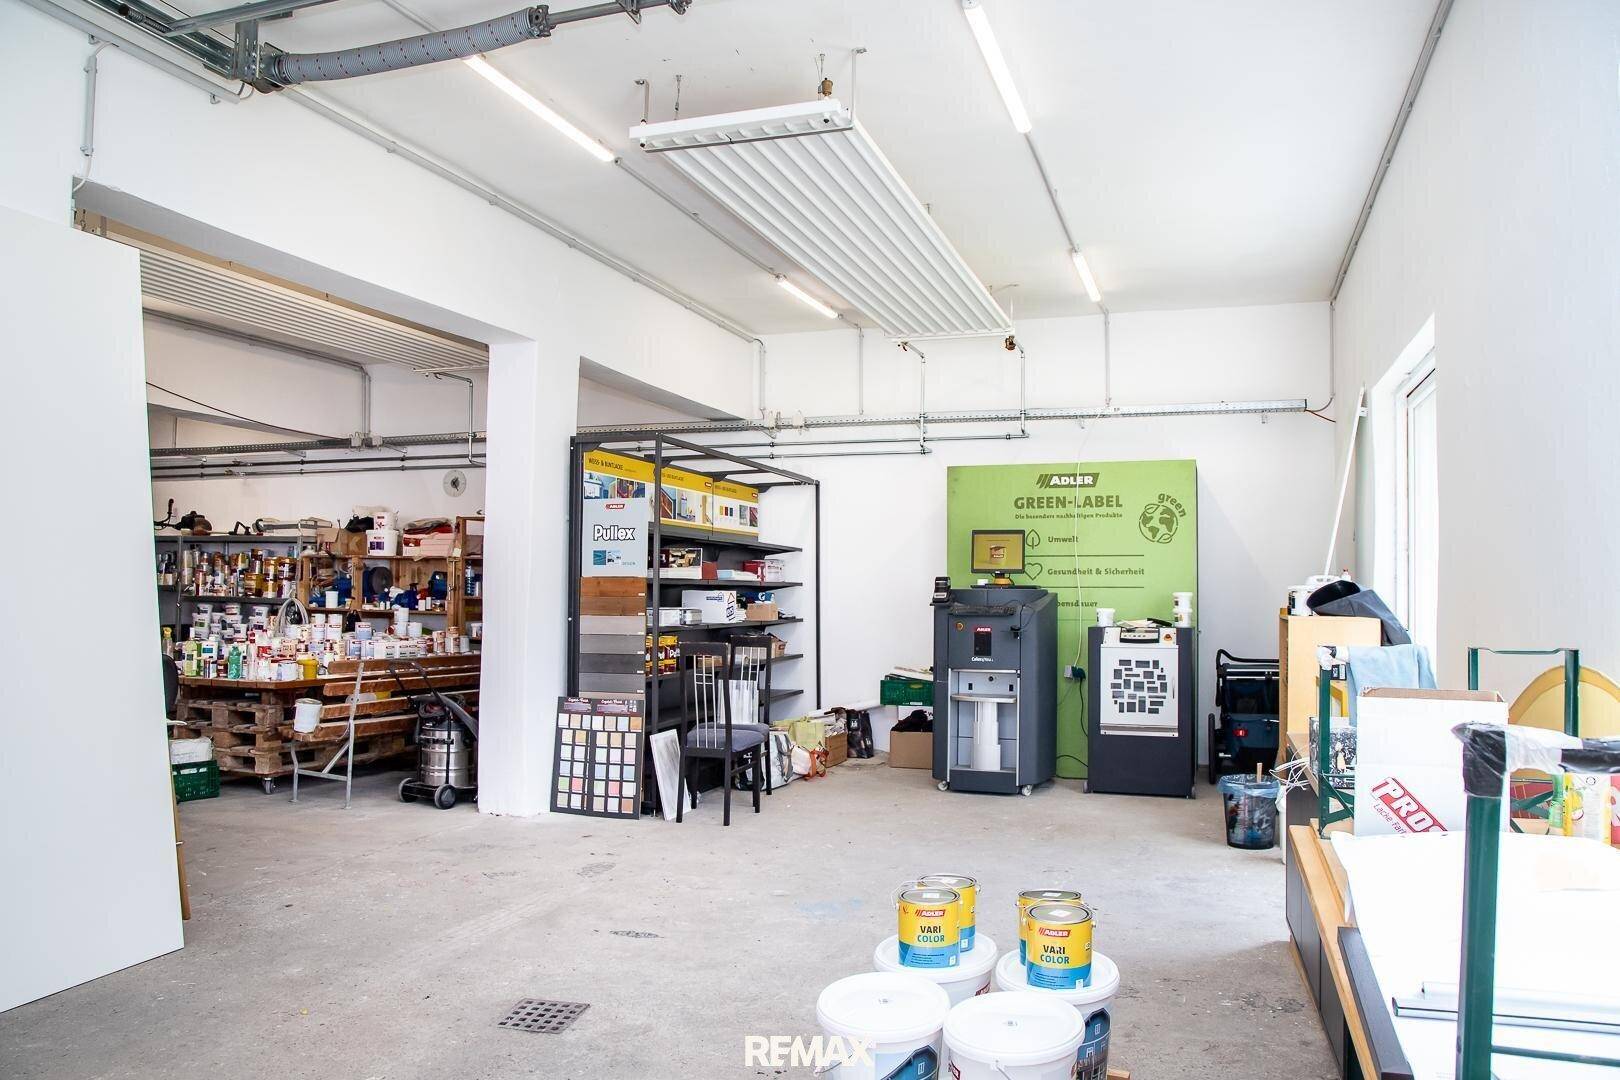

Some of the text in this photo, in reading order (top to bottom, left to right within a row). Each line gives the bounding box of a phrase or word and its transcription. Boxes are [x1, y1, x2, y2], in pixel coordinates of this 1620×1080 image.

[1049, 475, 1094, 486] ADLER
[1013, 495, 1123, 510] GREEN-LABEL
[1158, 493, 1186, 517] green
[593, 524, 636, 541] Pullex
[1104, 567, 1145, 575] Sicherheit
[920, 925, 941, 934] VARI
[917, 935, 945, 943] COLOR
[1043, 945, 1066, 955] VARI
[1040, 955, 1070, 964] COLOR
